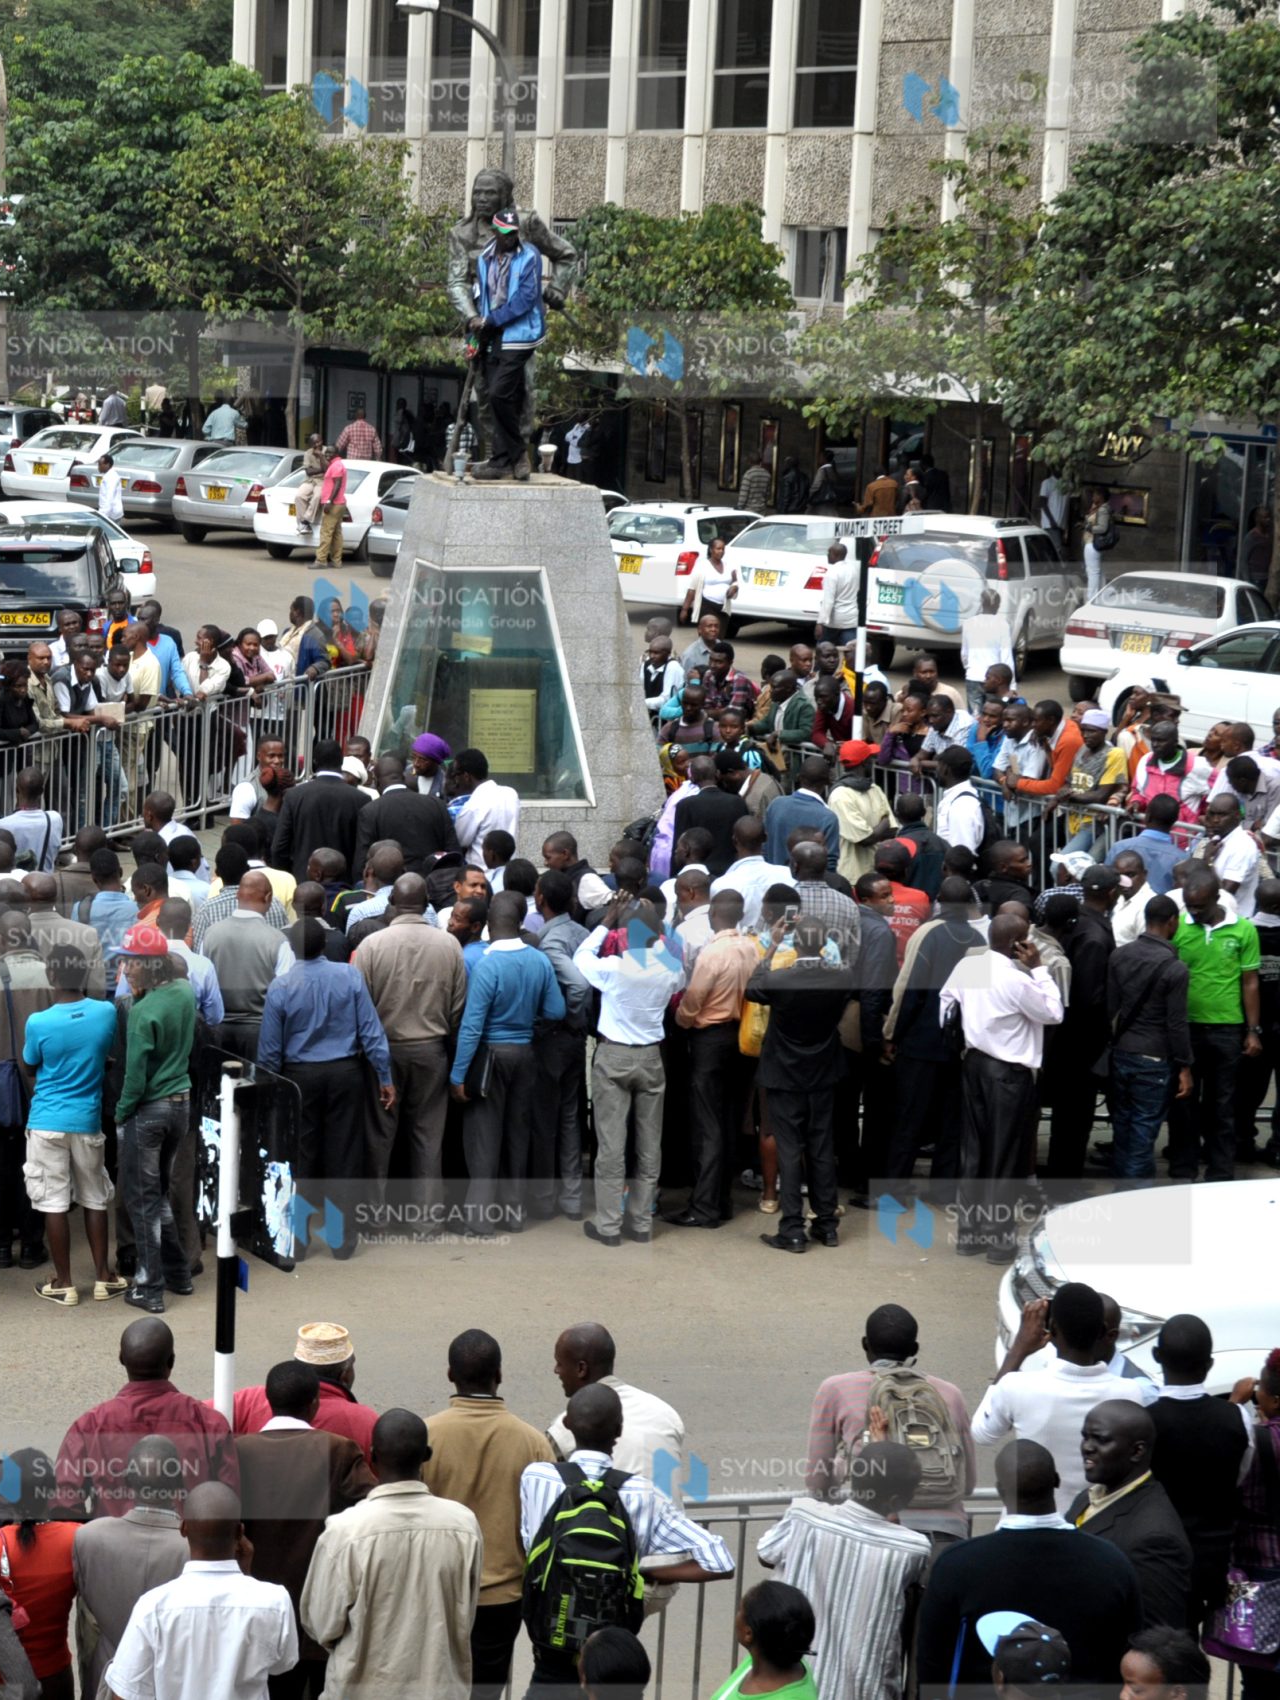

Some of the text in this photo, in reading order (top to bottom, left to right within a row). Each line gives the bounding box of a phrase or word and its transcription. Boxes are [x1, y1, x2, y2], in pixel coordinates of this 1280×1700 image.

[834, 518, 904, 537] KIMATHI STREET
[881, 586, 899, 595] KBU
[879, 593, 904, 604] 665T
[0, 613, 48, 624] KBX 676C
